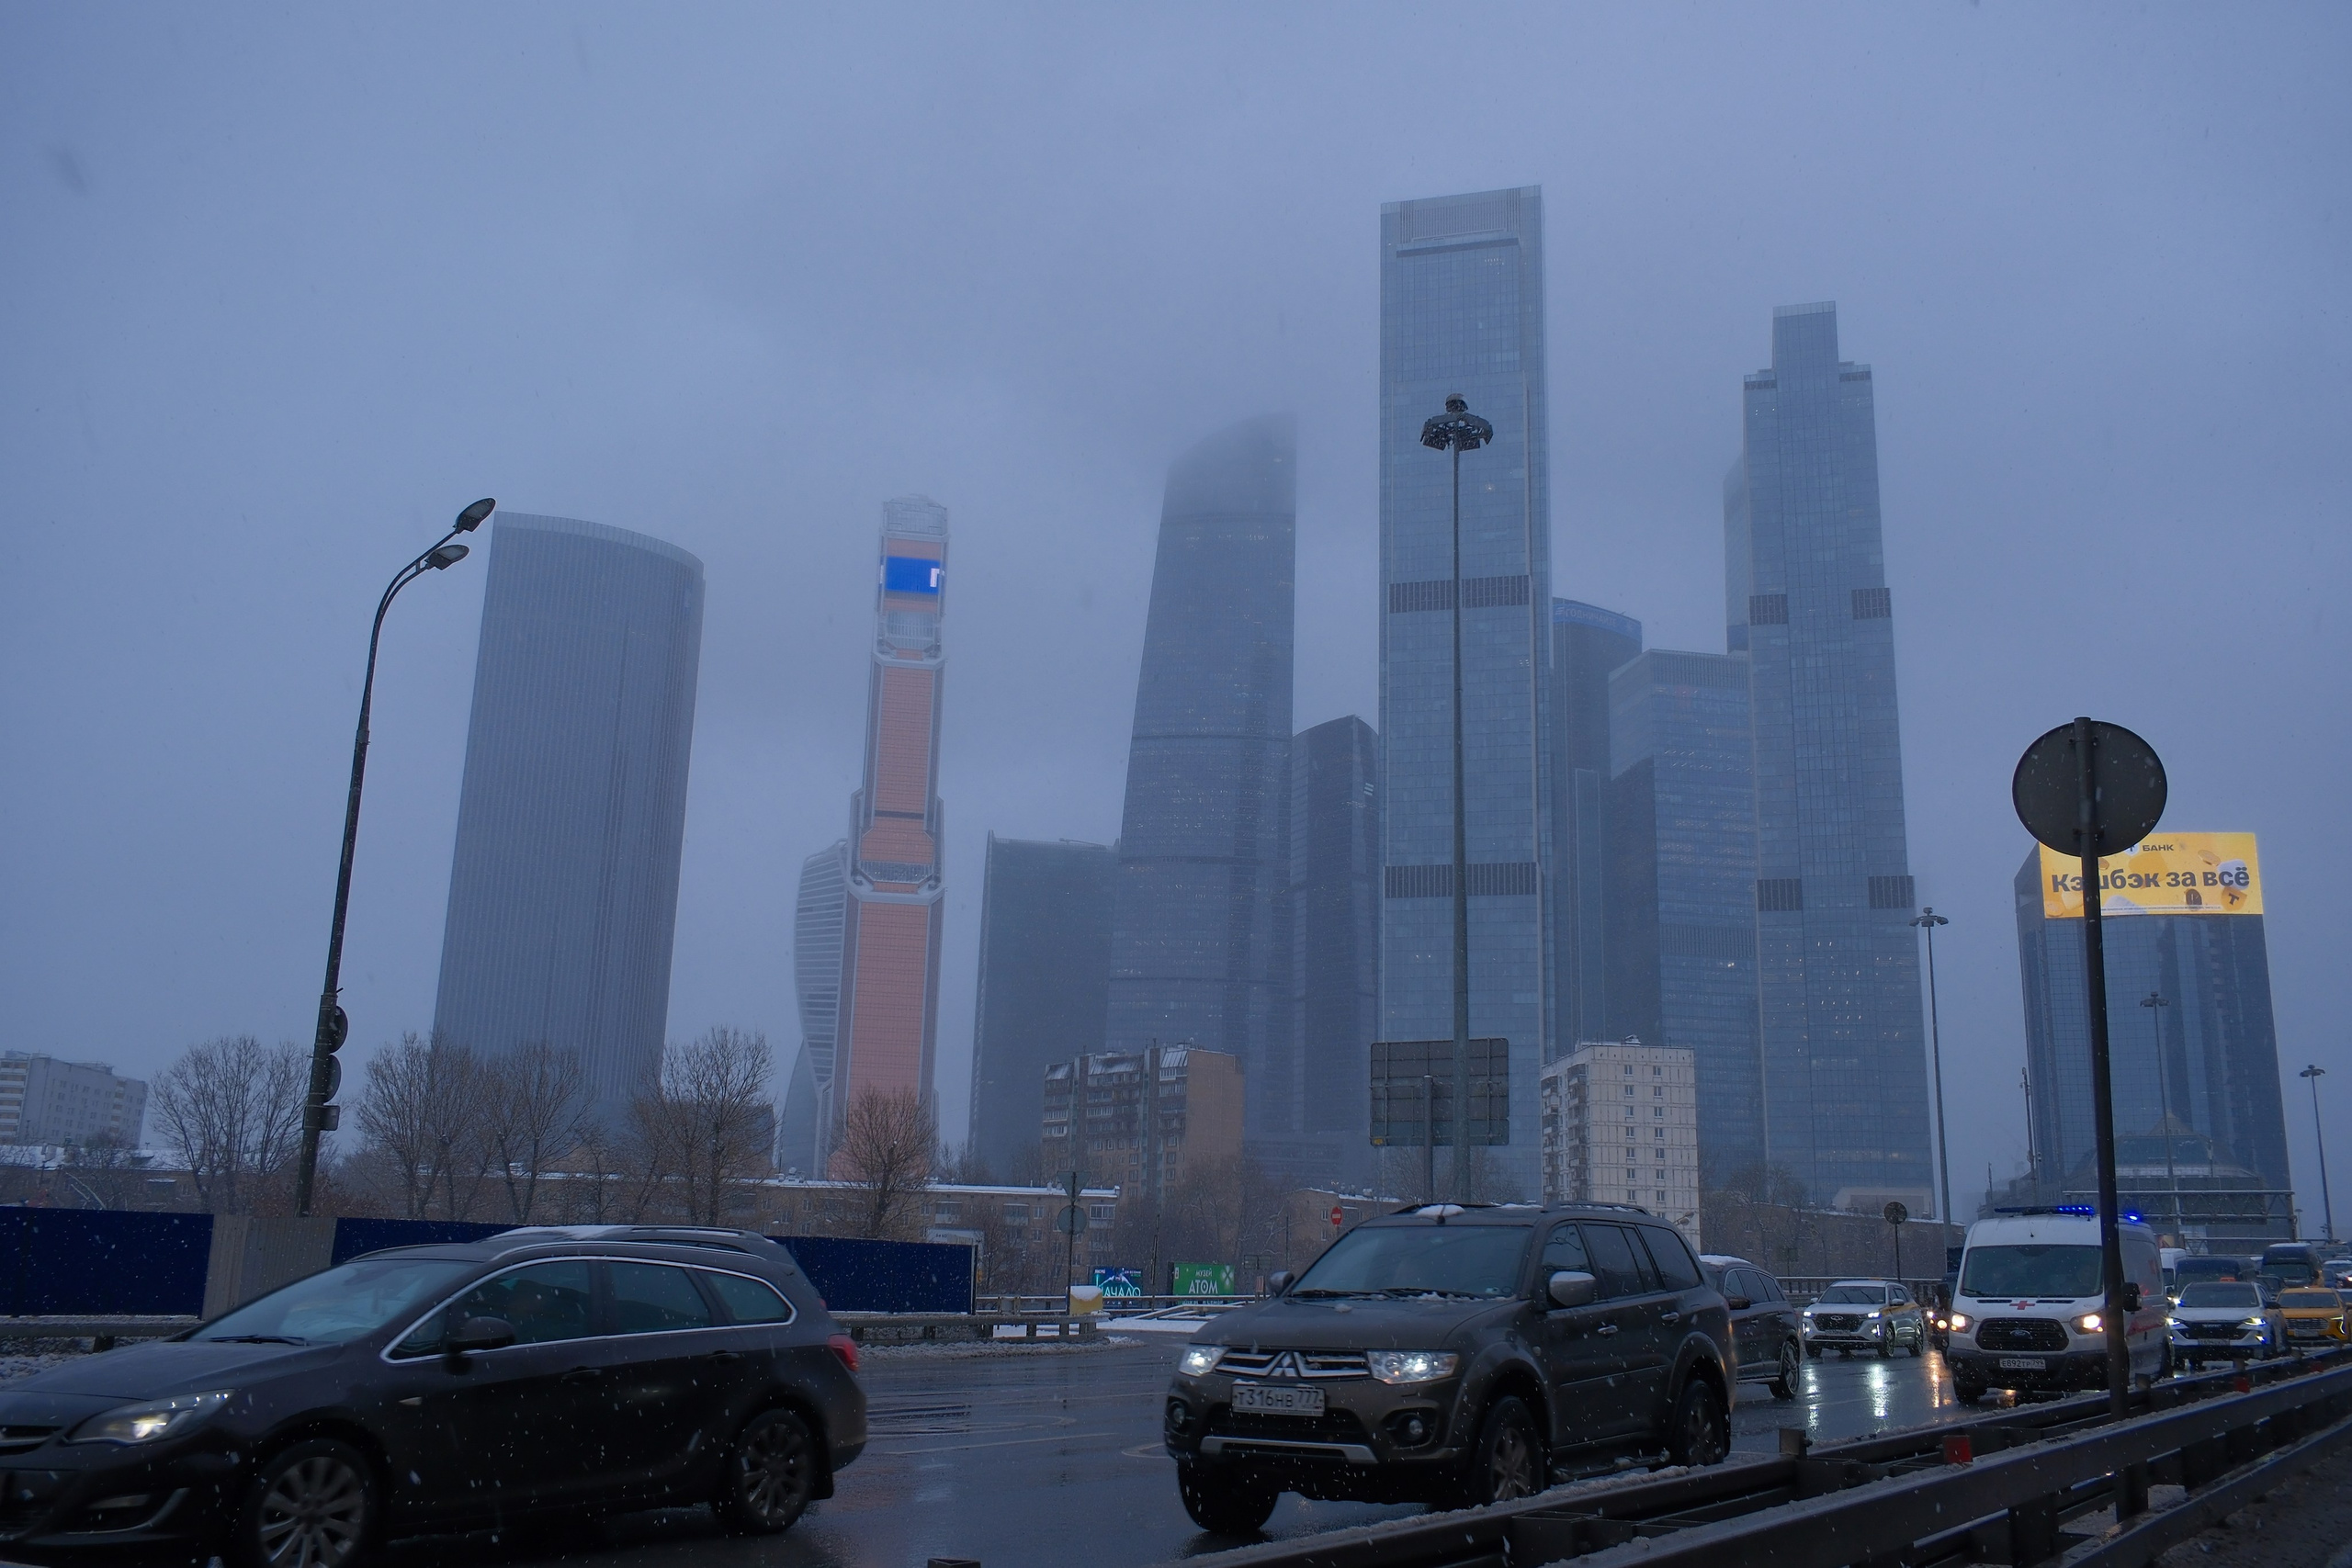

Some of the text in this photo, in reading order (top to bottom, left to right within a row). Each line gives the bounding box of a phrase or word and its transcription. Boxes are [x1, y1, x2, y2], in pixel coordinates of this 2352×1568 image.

[2166, 870, 2197, 888] за
[2202, 866, 2250, 886] всё
[1188, 1279, 1218, 1294] АТОМ
[1297, 1390, 1319, 1404] 777
